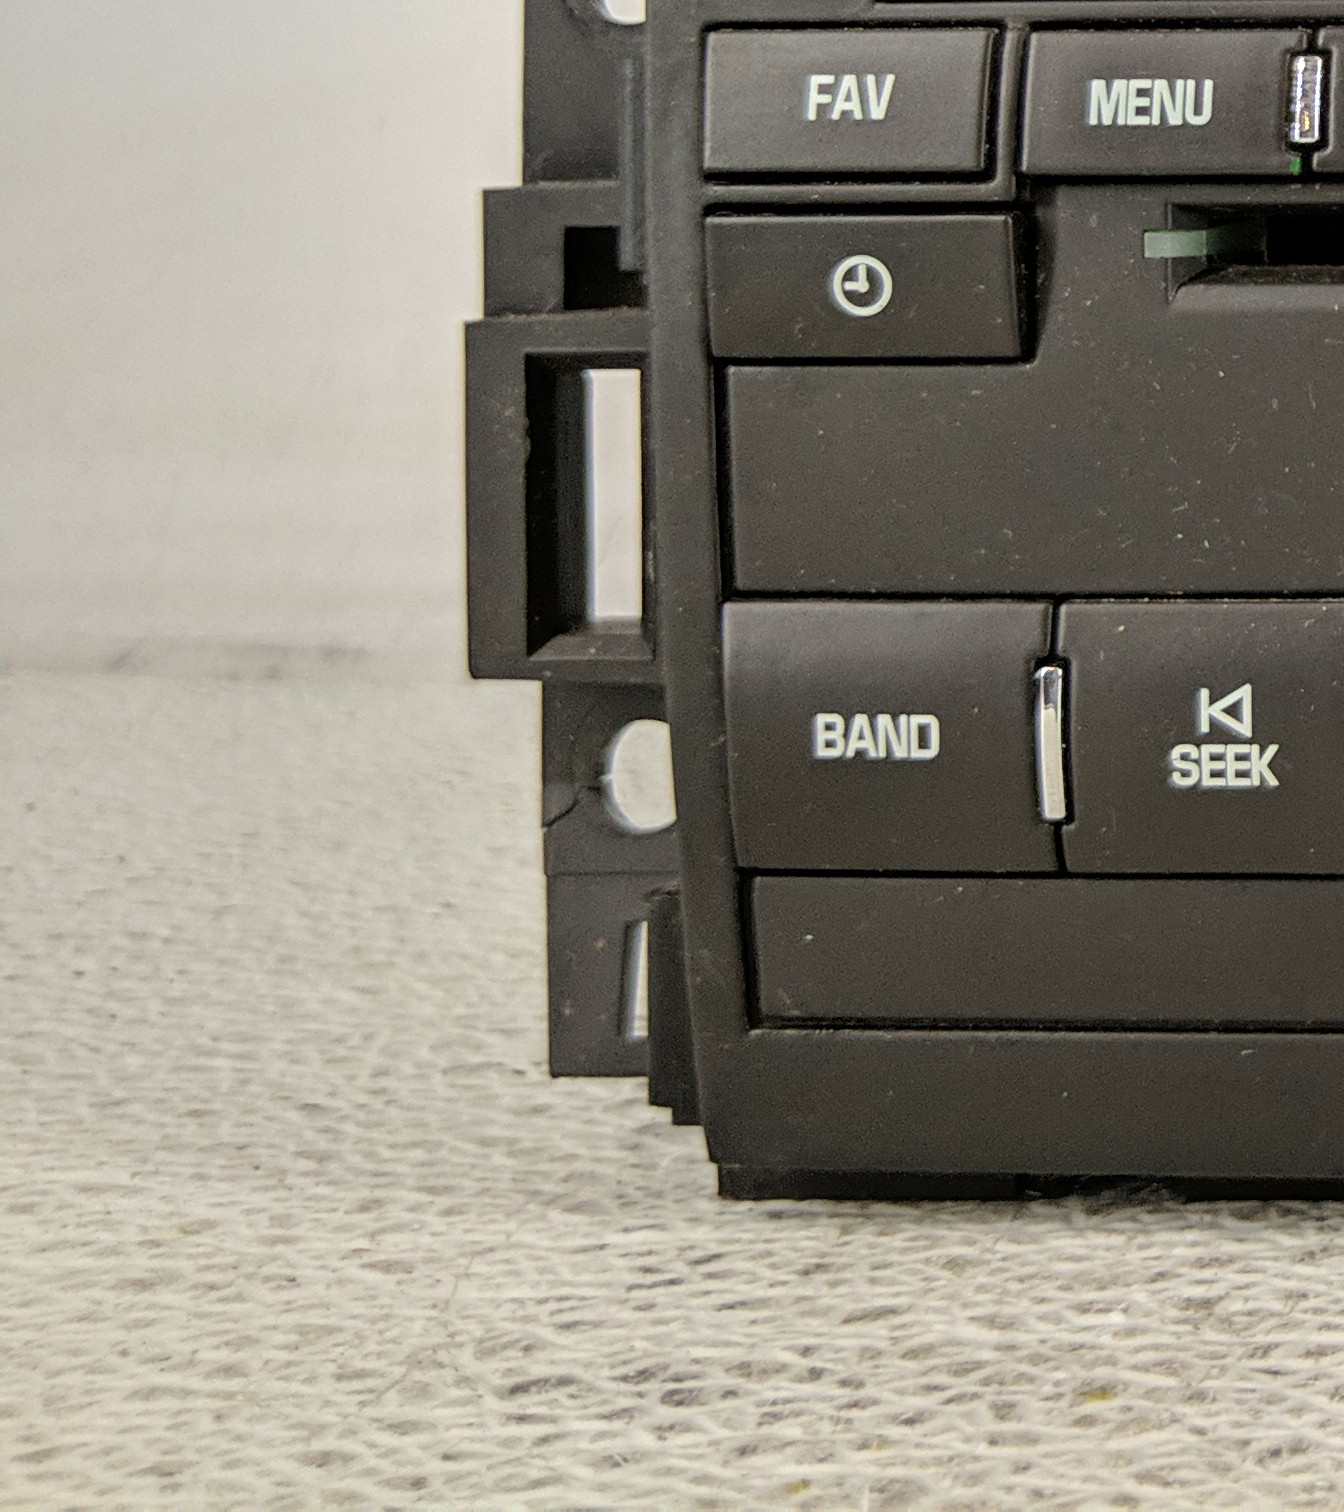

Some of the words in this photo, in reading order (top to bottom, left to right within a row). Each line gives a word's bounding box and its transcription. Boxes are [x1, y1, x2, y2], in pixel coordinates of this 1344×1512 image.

[805, 73, 896, 122] FAV
[1085, 78, 1215, 127] MENU
[812, 712, 941, 761] BAND
[1167, 743, 1280, 789] SEEK
